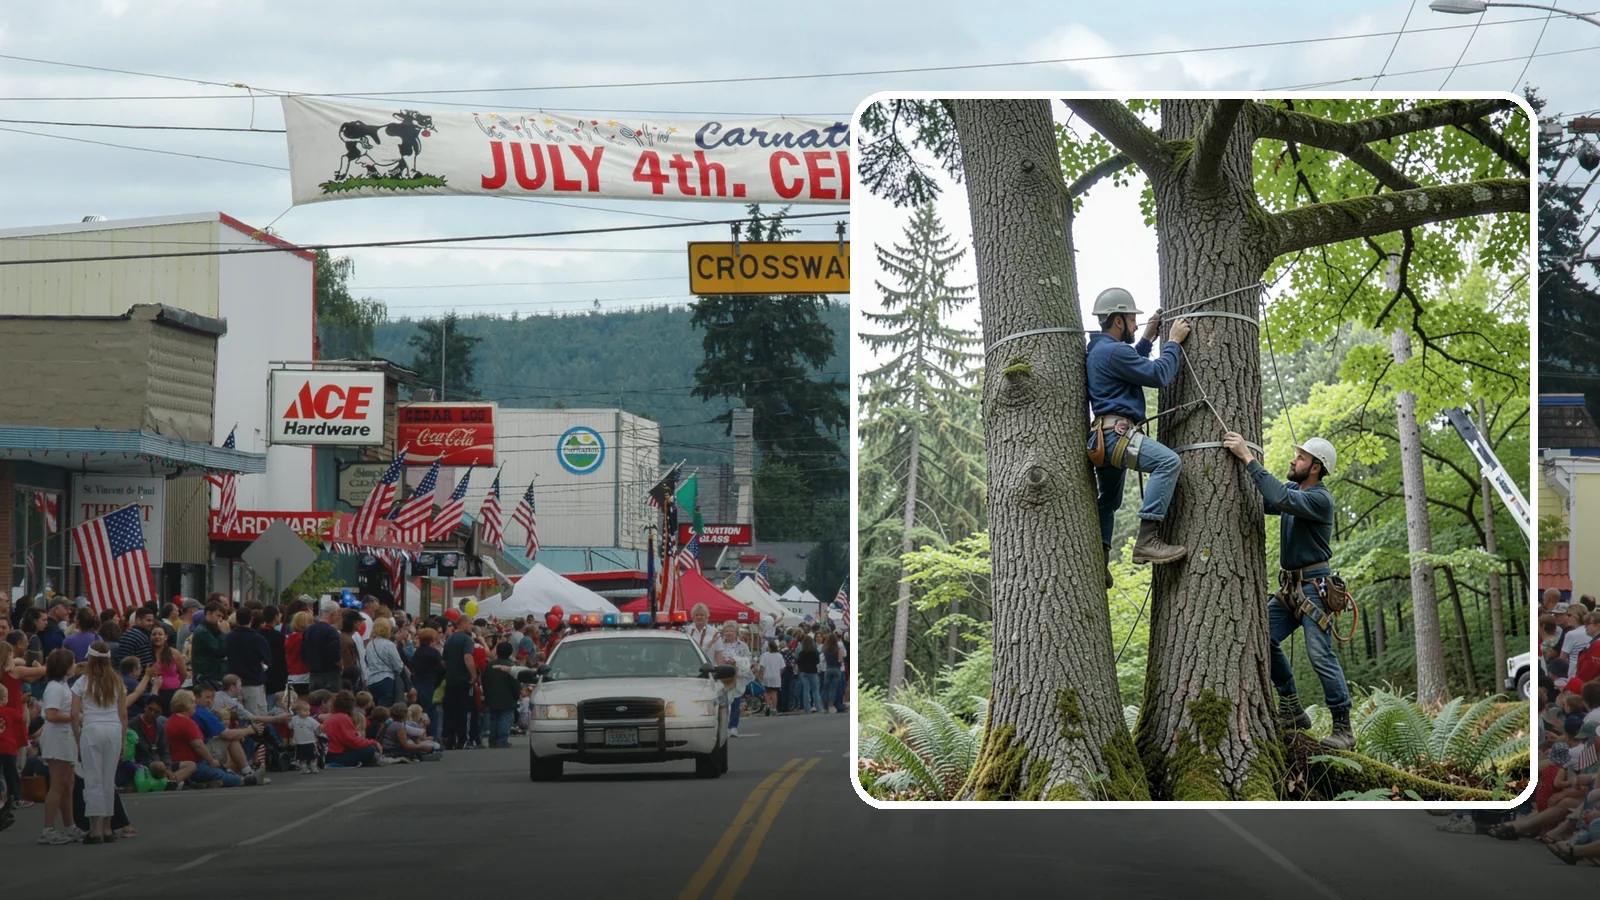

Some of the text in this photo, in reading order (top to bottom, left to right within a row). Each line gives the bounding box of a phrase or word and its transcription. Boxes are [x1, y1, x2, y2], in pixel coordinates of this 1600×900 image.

[481, 141, 605, 193] JULY
[632, 150, 747, 198] 4th.
[696, 254, 850, 280] CROSSWA
[283, 379, 374, 420] ACE
[405, 408, 453, 422] CEDAR
[283, 421, 371, 436] Hardware
[416, 428, 477, 447] Coca-Cola
[353, 467, 385, 480] Simpl
[83, 484, 155, 495] St. Vincent de Paul
[212, 516, 331, 536] HARDARE
[688, 526, 741, 535] CRNATION
[699, 535, 730, 543] GLASS
